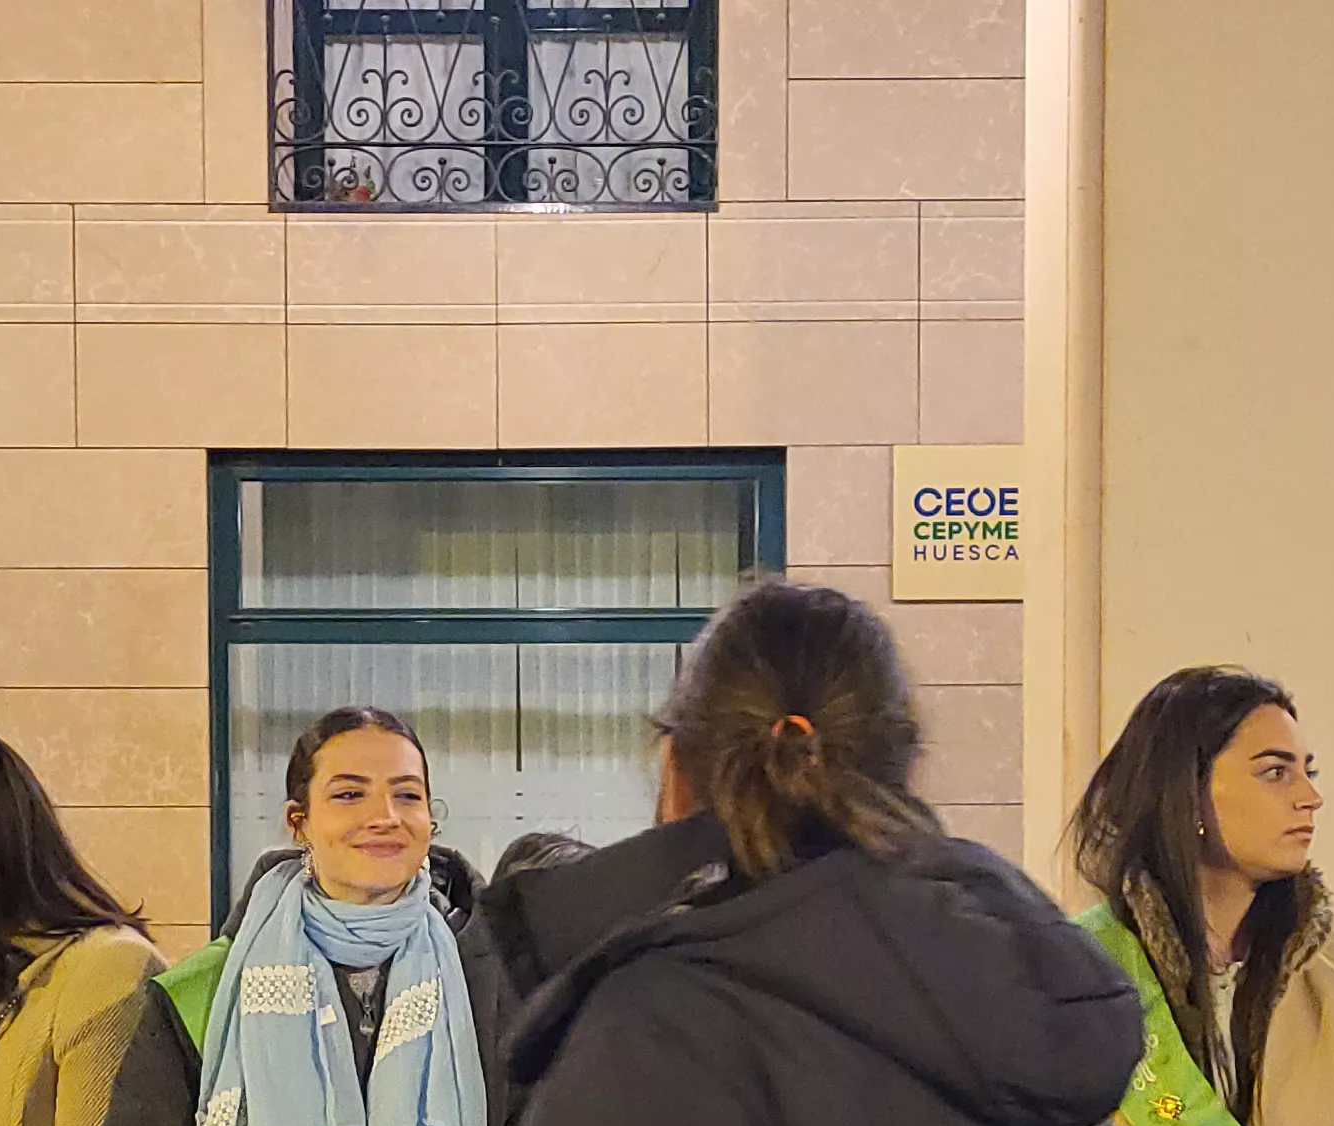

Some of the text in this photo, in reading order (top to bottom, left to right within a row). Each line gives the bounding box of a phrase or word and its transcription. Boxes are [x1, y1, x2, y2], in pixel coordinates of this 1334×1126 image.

[914, 487, 1019, 517] CEOE
[914, 521, 1019, 540] CEPYME
[914, 544, 1019, 561] HUESCA
